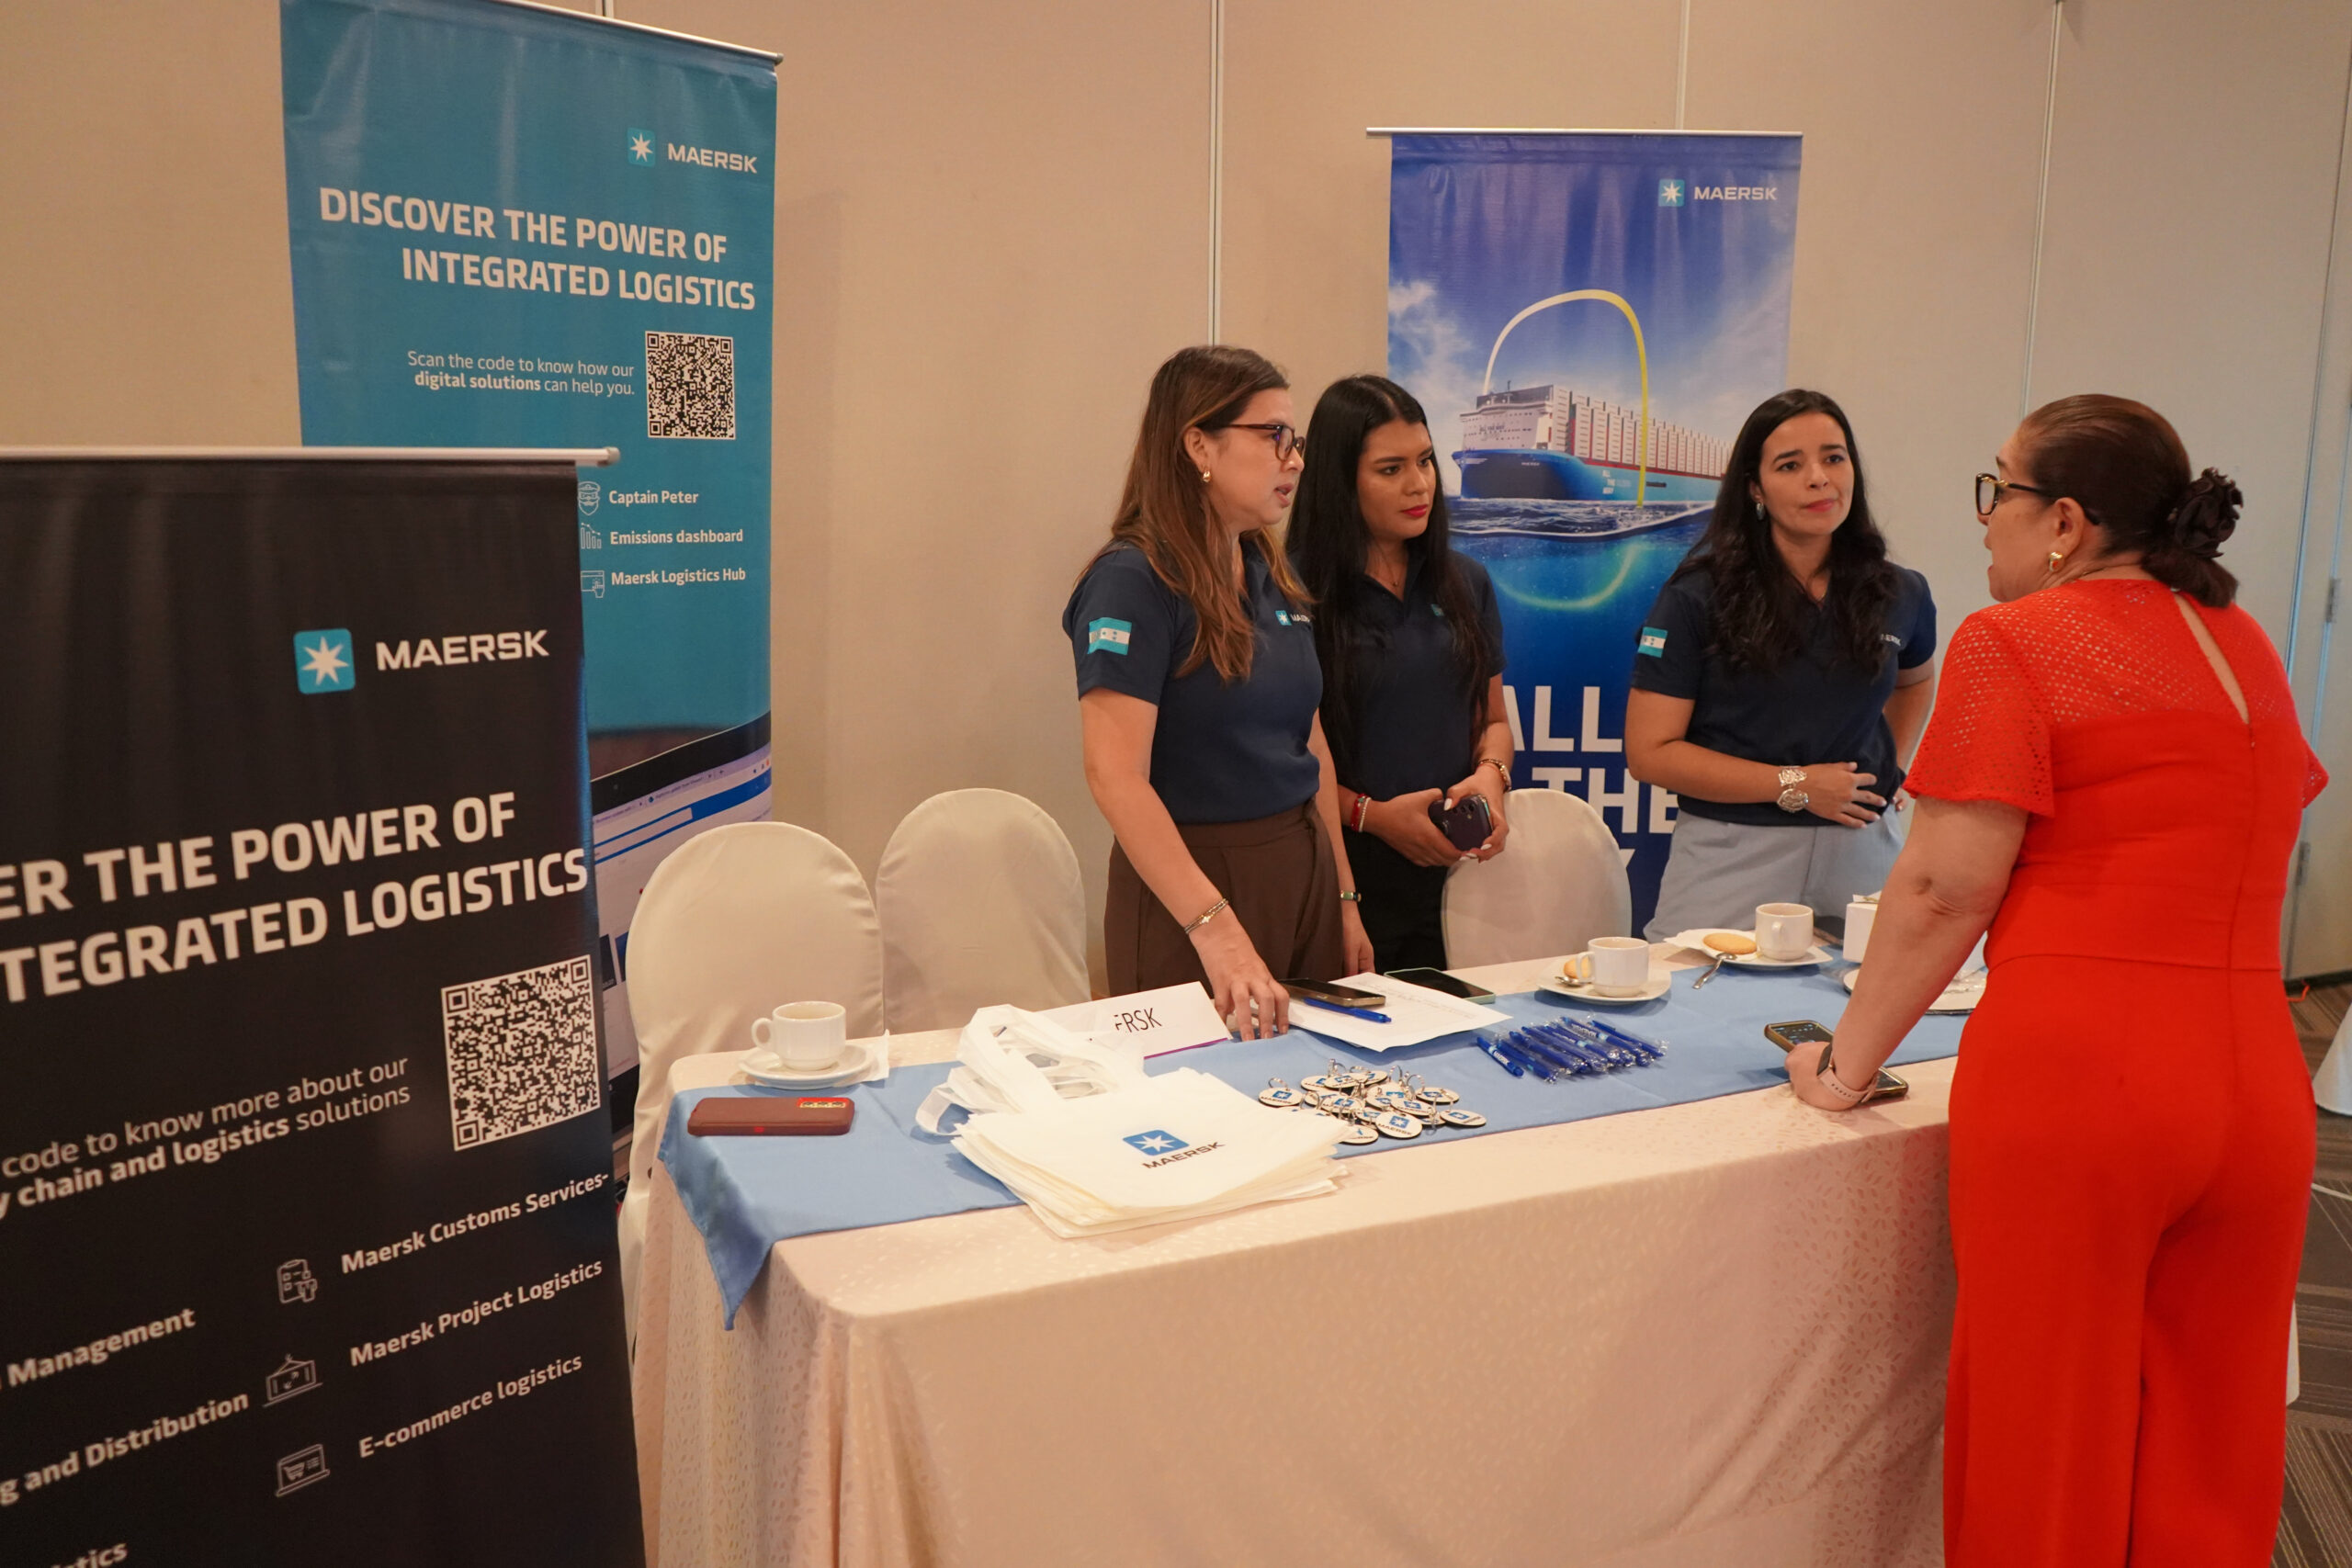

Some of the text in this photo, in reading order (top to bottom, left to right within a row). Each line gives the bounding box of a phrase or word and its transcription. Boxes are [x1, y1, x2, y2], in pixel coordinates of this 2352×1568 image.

[668, 142, 758, 175] MAERSK
[320, 187, 727, 264] DISCOVER THE POWER OF
[1693, 186, 1778, 201] MAERSK
[402, 248, 756, 310] INTEGRATED LOGISTICS
[408, 351, 634, 377] Scan the code to know how our
[414, 372, 635, 398] digital solutions can help you.
[608, 490, 699, 507] Captain Peter
[610, 529, 743, 545] Emissions dashboard
[611, 568, 746, 586] Maersk Logistics Hub
[376, 630, 548, 671] MAERSK
[1532, 767, 1679, 834] THE
[84, 835, 217, 904] THE
[232, 805, 439, 880] POWER
[452, 792, 515, 842] OF
[344, 849, 588, 937] LOGISTICS
[1114, 1007, 1162, 1032] RSK
[2, 1056, 409, 1178] code to know more about our
[17, 1167, 104, 1206] chain
[109, 1145, 167, 1182] and
[173, 1115, 290, 1167] logistics
[295, 1084, 412, 1133] solutions
[1142, 1141, 1225, 1169] MAERSK
[342, 1232, 426, 1274] Maersk
[430, 1201, 521, 1243] Customs
[350, 1259, 603, 1368] Maersk Project Logistics
[8, 1307, 197, 1387] Management
[359, 1355, 583, 1459] E-commerce logistics
[25, 1450, 80, 1491] and
[85, 1393, 250, 1468] Distribution
